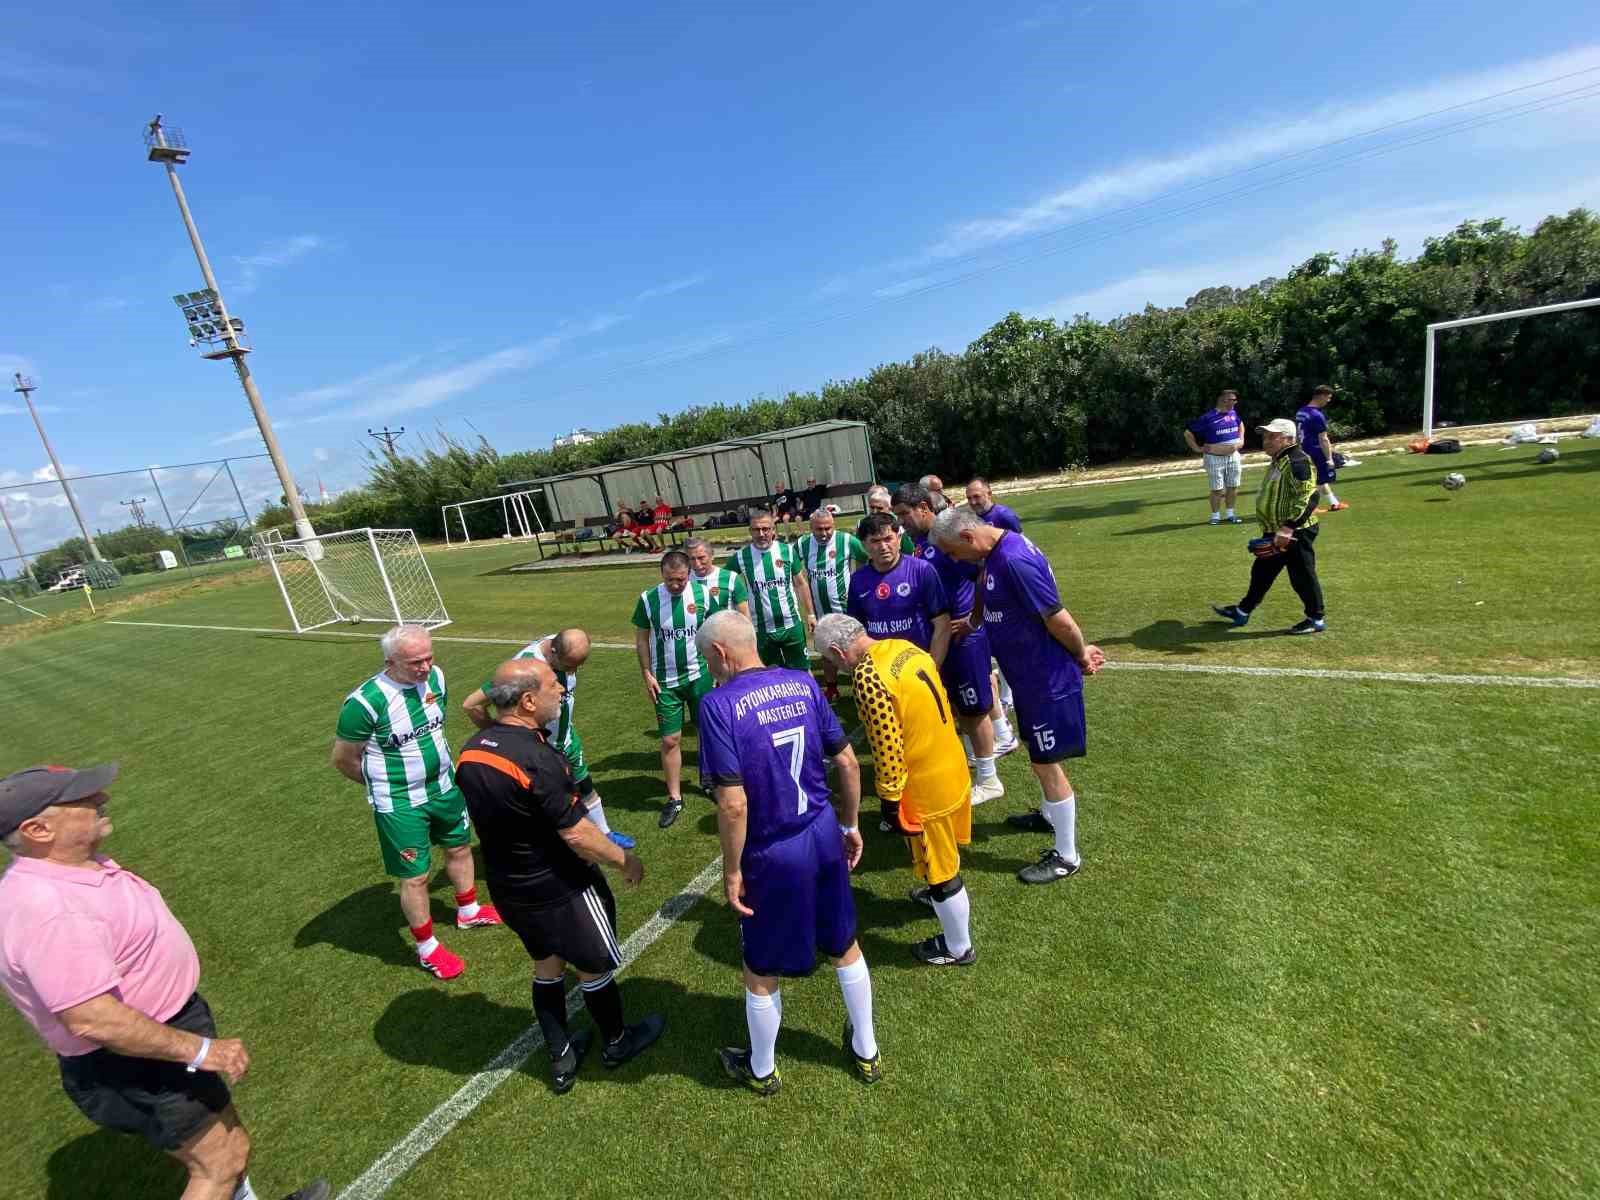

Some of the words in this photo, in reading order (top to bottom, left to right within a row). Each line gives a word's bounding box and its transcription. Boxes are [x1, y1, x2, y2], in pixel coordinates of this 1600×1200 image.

[890, 617, 913, 632] SHOP
[916, 669, 947, 725] 1
[960, 688, 978, 706] 19
[757, 701, 808, 725] MASTERLER
[1034, 730, 1056, 752] 15
[772, 725, 808, 816] 7
